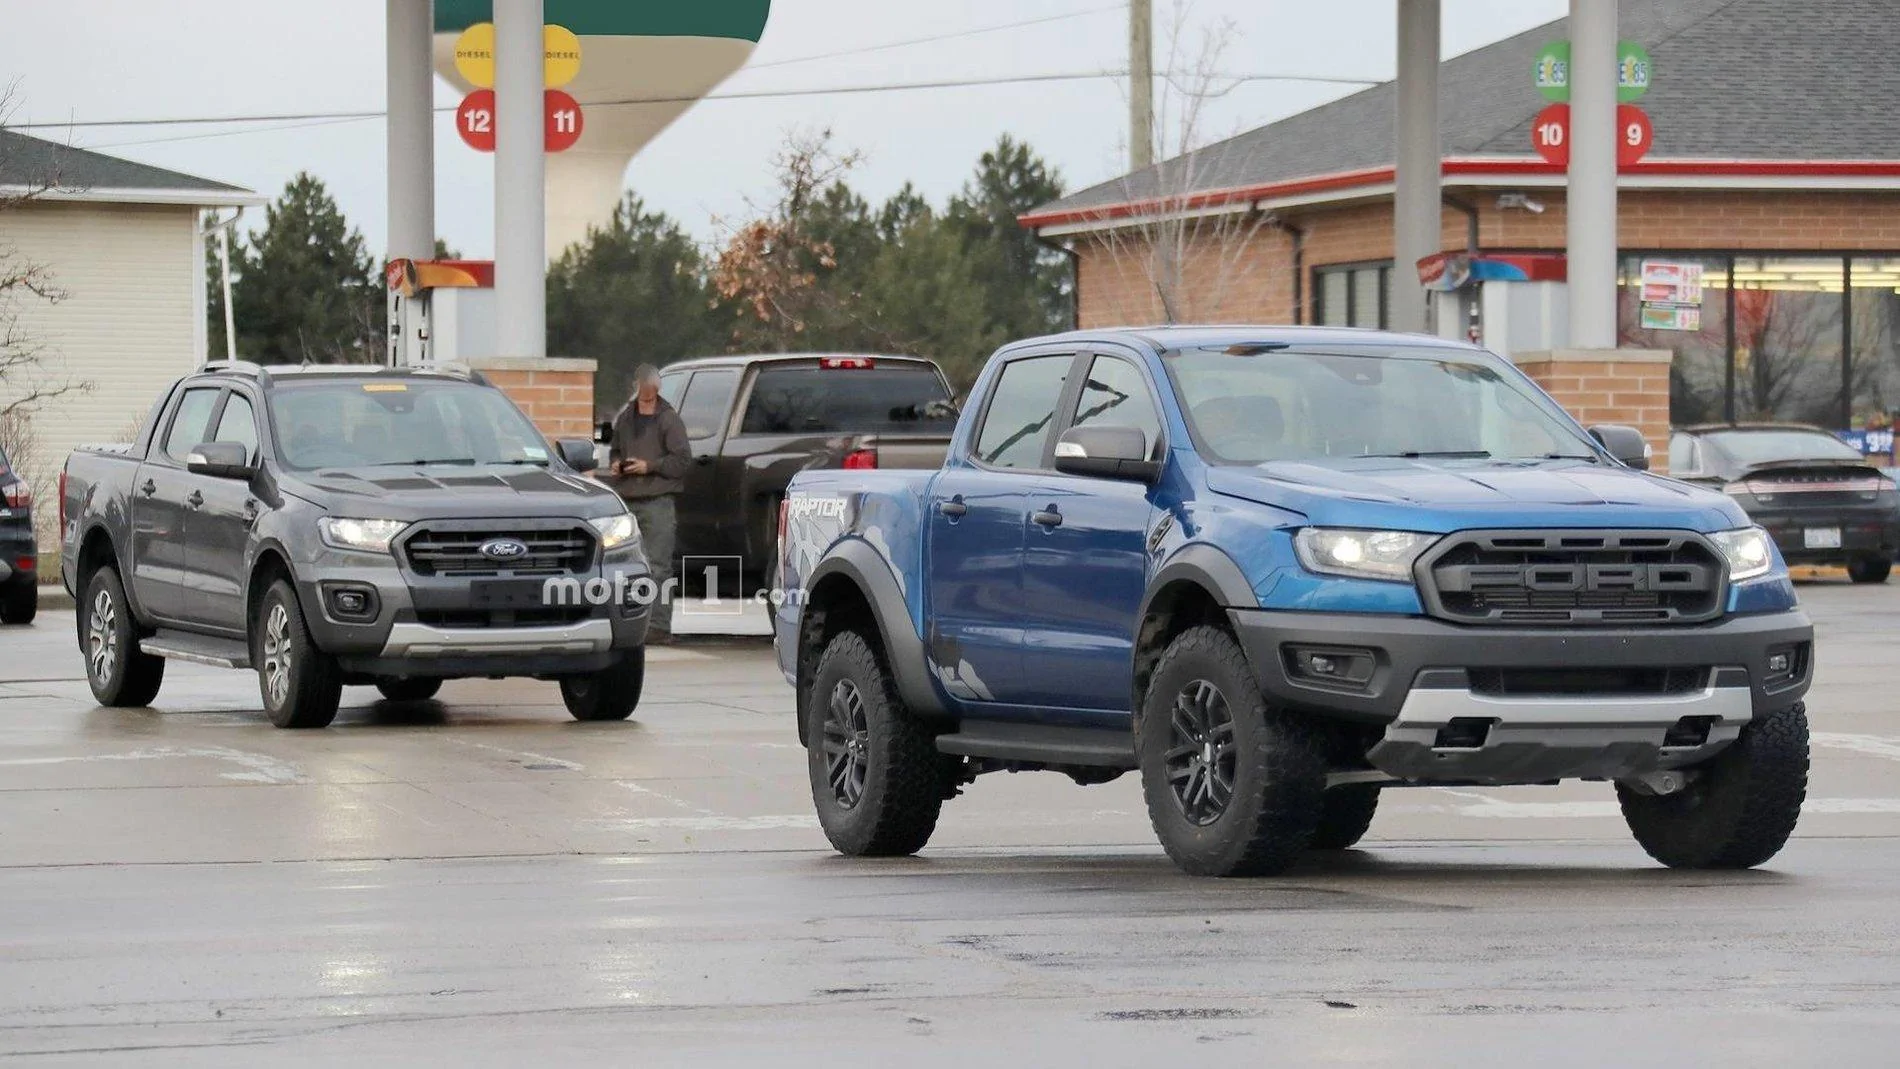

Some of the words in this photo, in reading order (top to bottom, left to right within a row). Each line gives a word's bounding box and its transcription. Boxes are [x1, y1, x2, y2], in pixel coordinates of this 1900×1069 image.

[456, 51, 492, 59] DIESEL
[545, 51, 580, 60] DIESEL
[464, 109, 491, 133] 12
[553, 110, 576, 133] 11
[1538, 123, 1563, 146] 10
[1627, 123, 1643, 146] 9
[791, 498, 848, 521] RAPTOR
[493, 543, 518, 555] Ford
[1460, 563, 1706, 592] FORD
